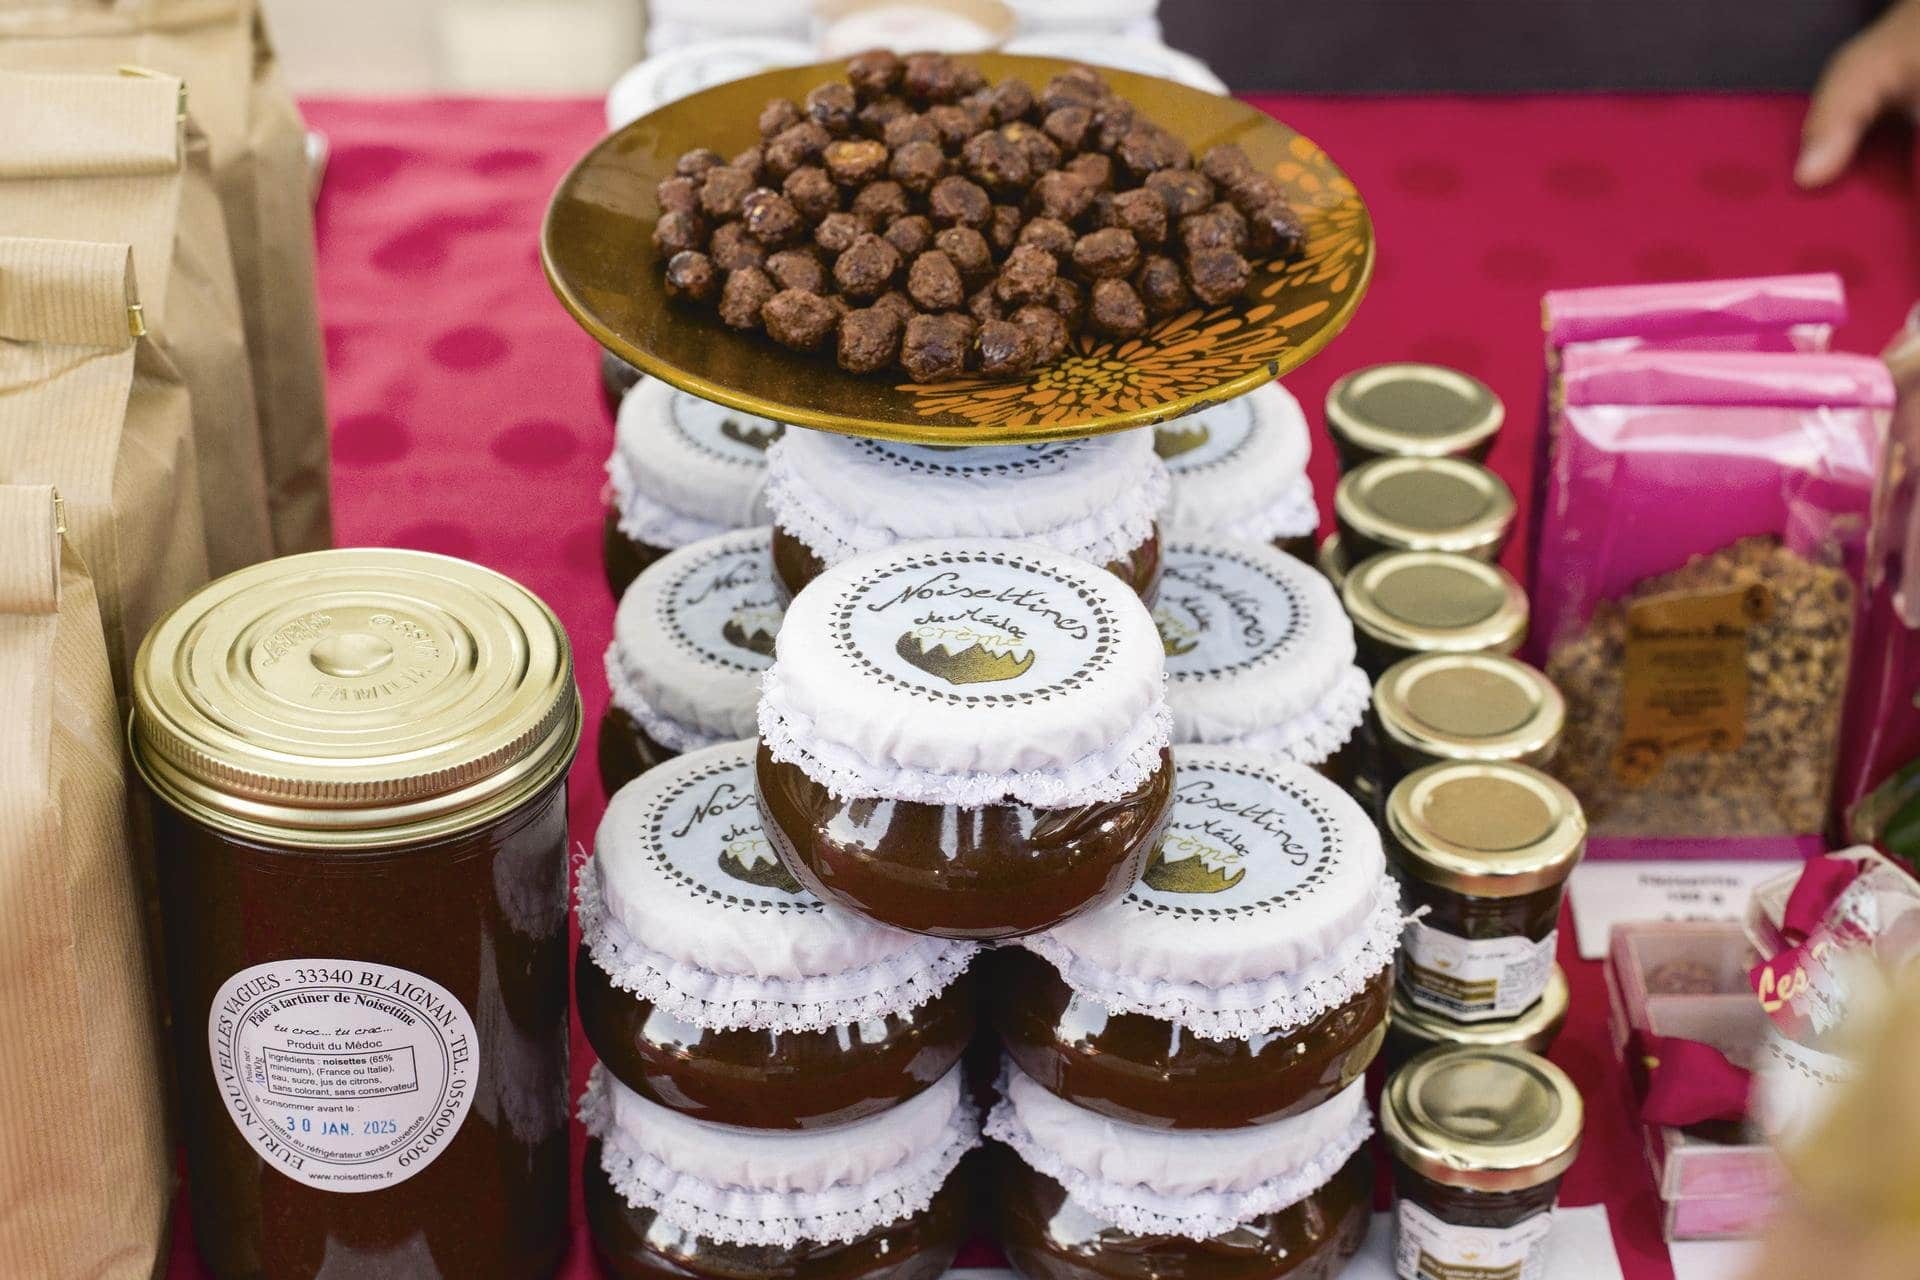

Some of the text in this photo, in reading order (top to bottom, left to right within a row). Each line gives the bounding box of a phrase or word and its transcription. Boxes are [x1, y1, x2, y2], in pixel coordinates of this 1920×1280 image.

[867, 572, 1088, 640] Noisettines
[914, 607, 1028, 639] du Médoc
[295, 969, 352, 984] 33340
[224, 973, 280, 1015] VAGUES
[358, 972, 457, 1027] BLAIGNAN
[248, 992, 416, 1028] Pâte à tartiner de Noisettine
[274, 1024, 393, 1036] tu croc... tu crac...
[287, 1039, 383, 1050] Produit du Médoc
[323, 1057, 367, 1066] noisettes
[369, 1054, 393, 1065] (65%
[217, 1015, 257, 1126] NOUVELLES
[317, 1068, 351, 1076] (France
[272, 1084, 292, 1093] sans
[358, 1082, 416, 1095] conservateur
[320, 1079, 333, 1087] jus
[263, 1099, 314, 1111] consommer
[317, 1104, 343, 1113] avant
[363, 1120, 397, 1134] 2025
[399, 1079, 466, 1167] 0556090309
[268, 1116, 425, 1159] mettre au réfrigérateur après ouverture
[258, 1127, 304, 1170] EURL
[308, 1171, 394, 1181] www.noisettines.fr
